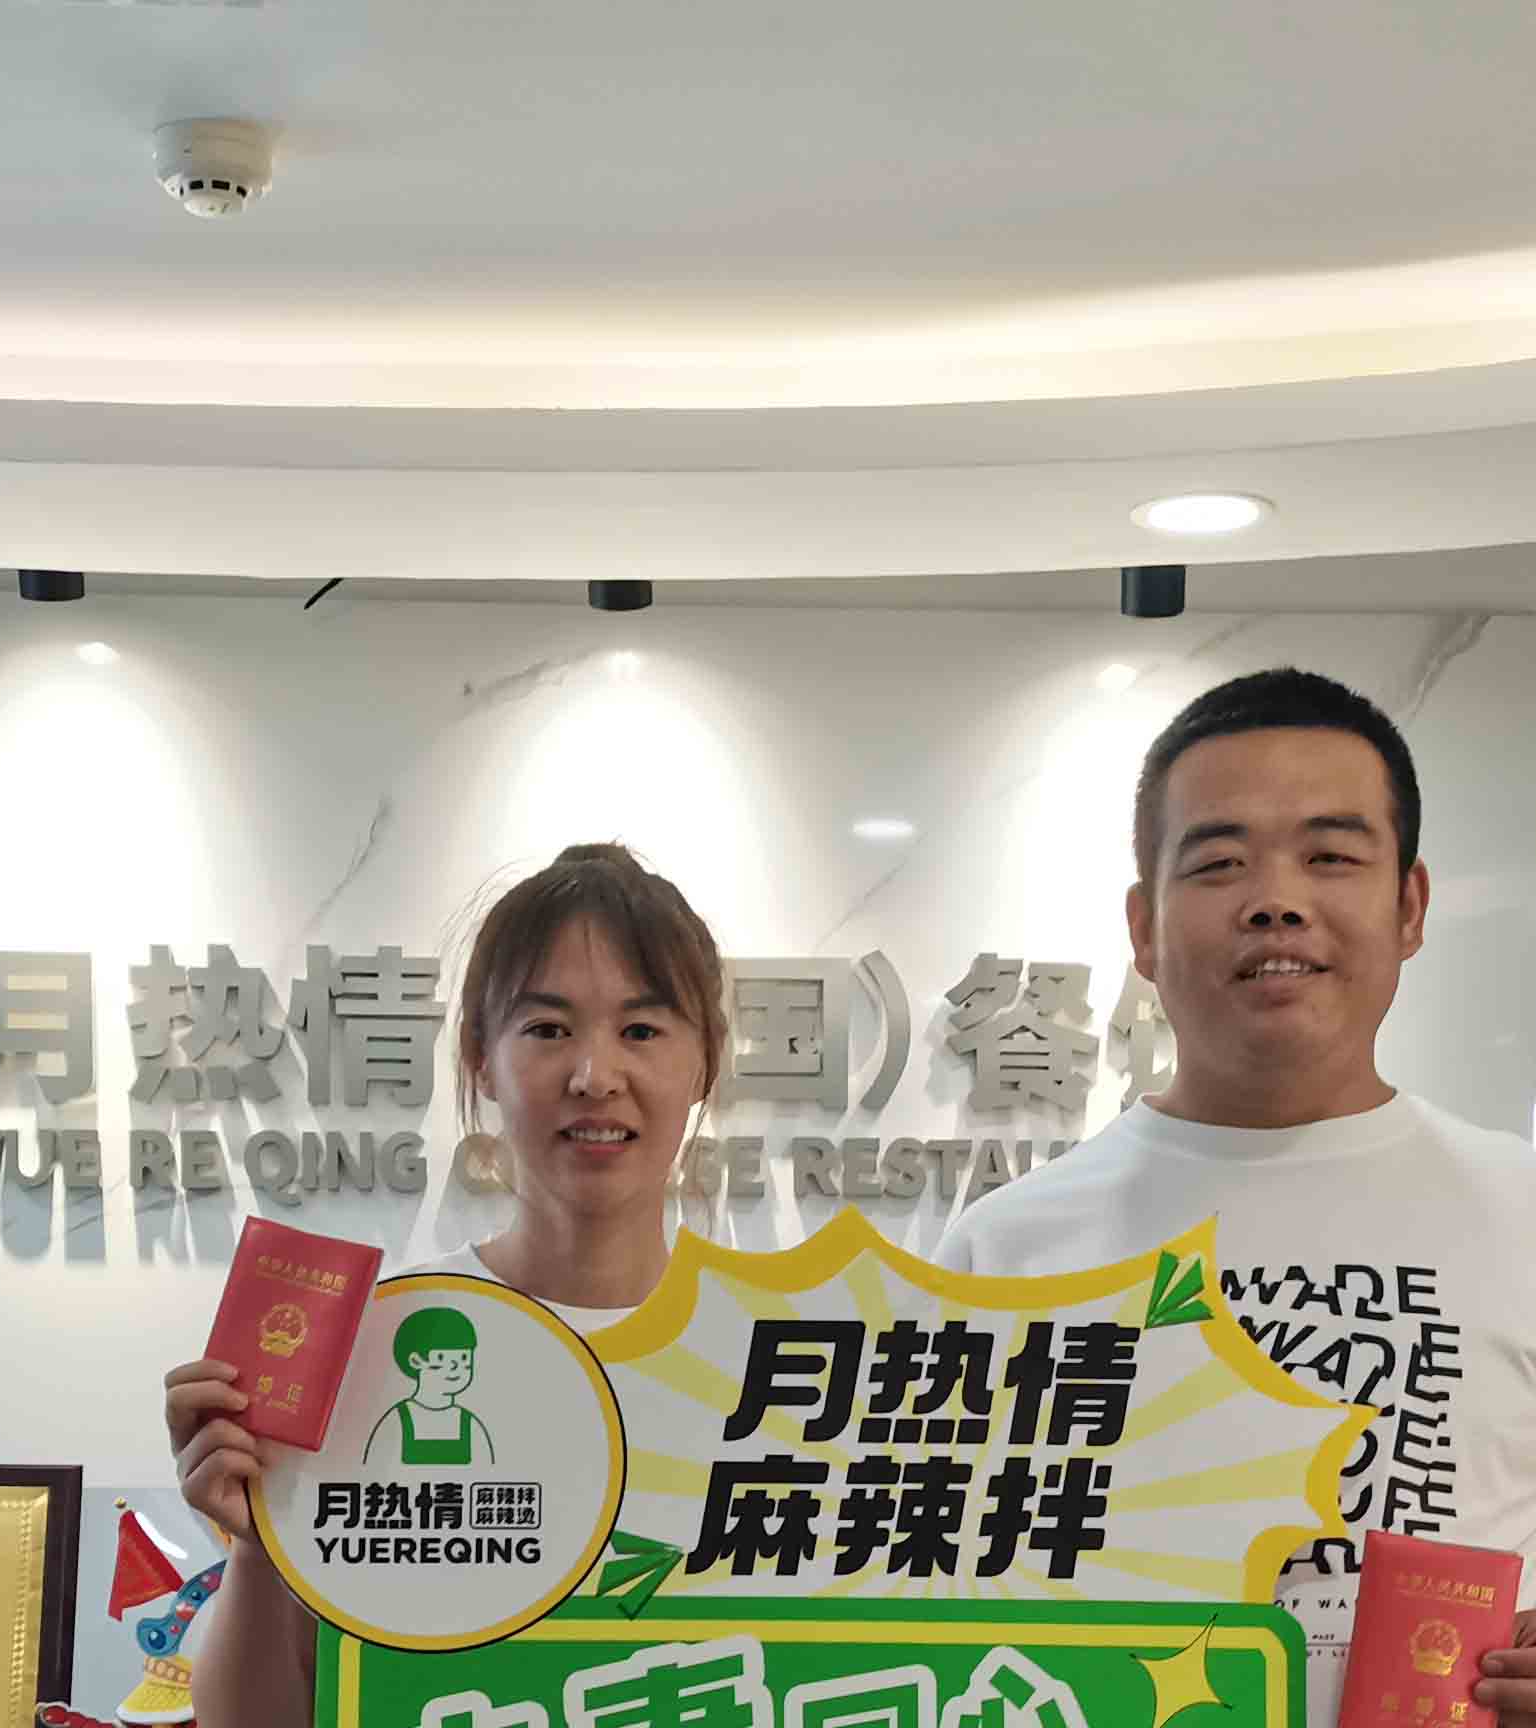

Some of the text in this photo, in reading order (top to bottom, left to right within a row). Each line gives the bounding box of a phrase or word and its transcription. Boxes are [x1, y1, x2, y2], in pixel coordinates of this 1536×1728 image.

[128, 1129, 224, 1192] RE
[243, 1130, 428, 1208] QING
[721, 1318, 1143, 1447] 月热情
[314, 1482, 464, 1530] 月热情
[684, 1453, 1113, 1581] 麻辣拌
[314, 1537, 542, 1564] YUEREQING
